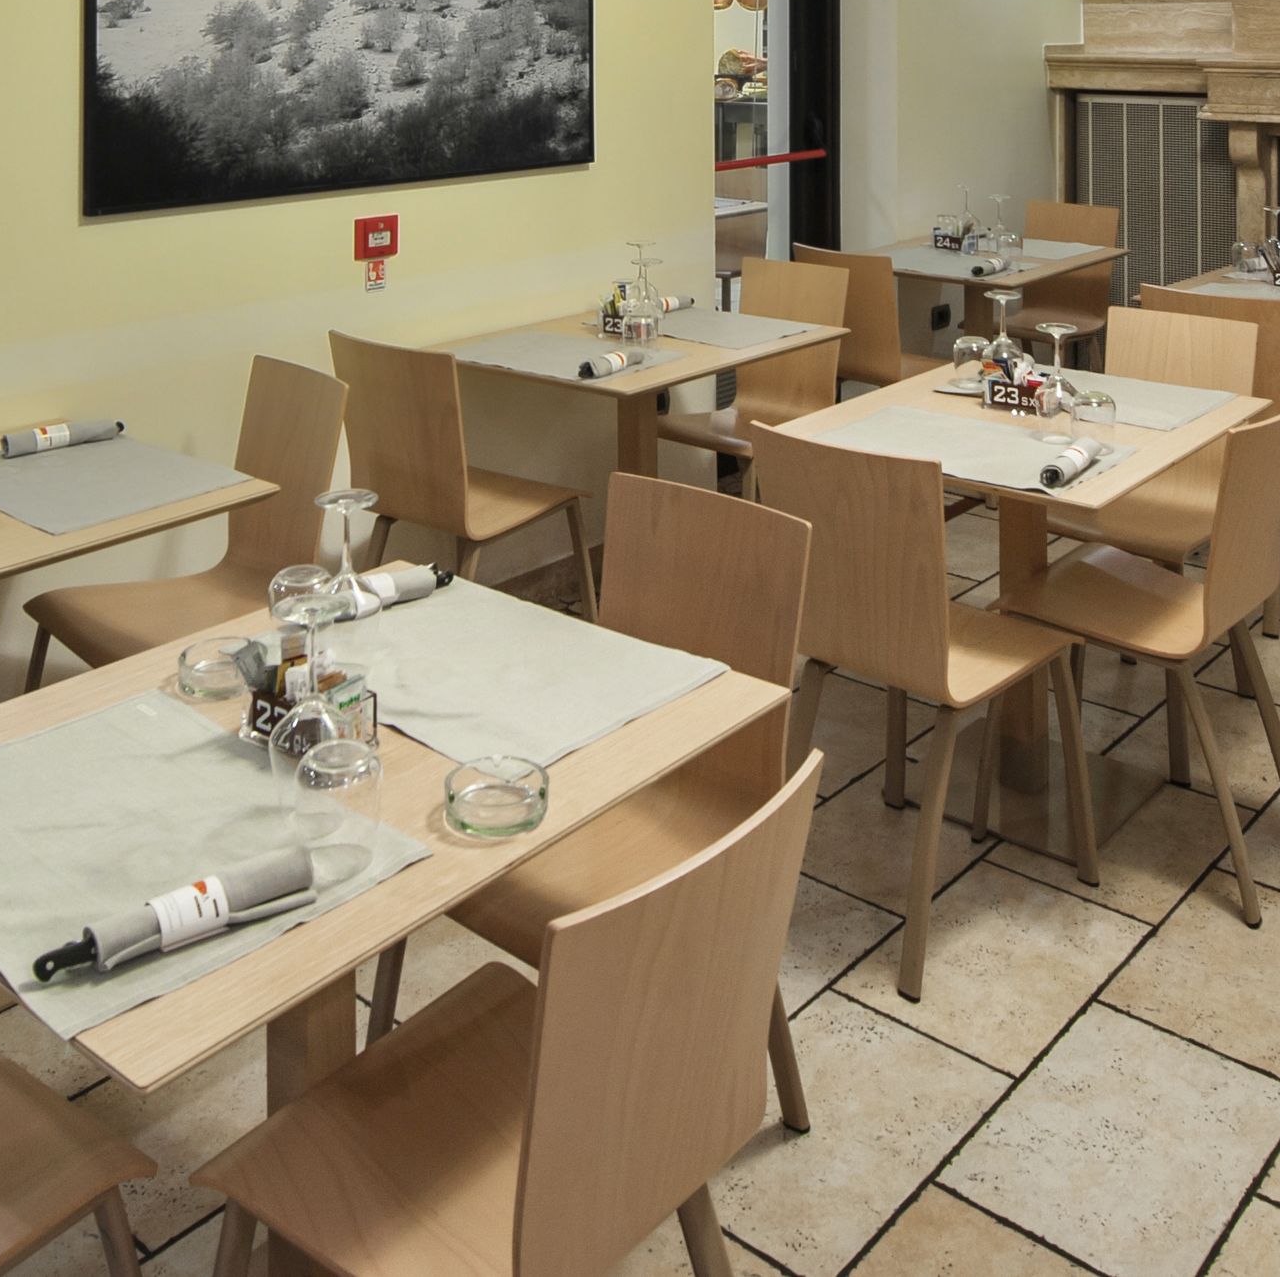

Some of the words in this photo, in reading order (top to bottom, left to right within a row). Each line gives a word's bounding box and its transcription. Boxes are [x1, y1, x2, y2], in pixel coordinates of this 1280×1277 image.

[936, 236, 951, 248] 24
[605, 318, 622, 332] 23
[993, 385, 1019, 405] 23
[1021, 396, 1037, 407] SX
